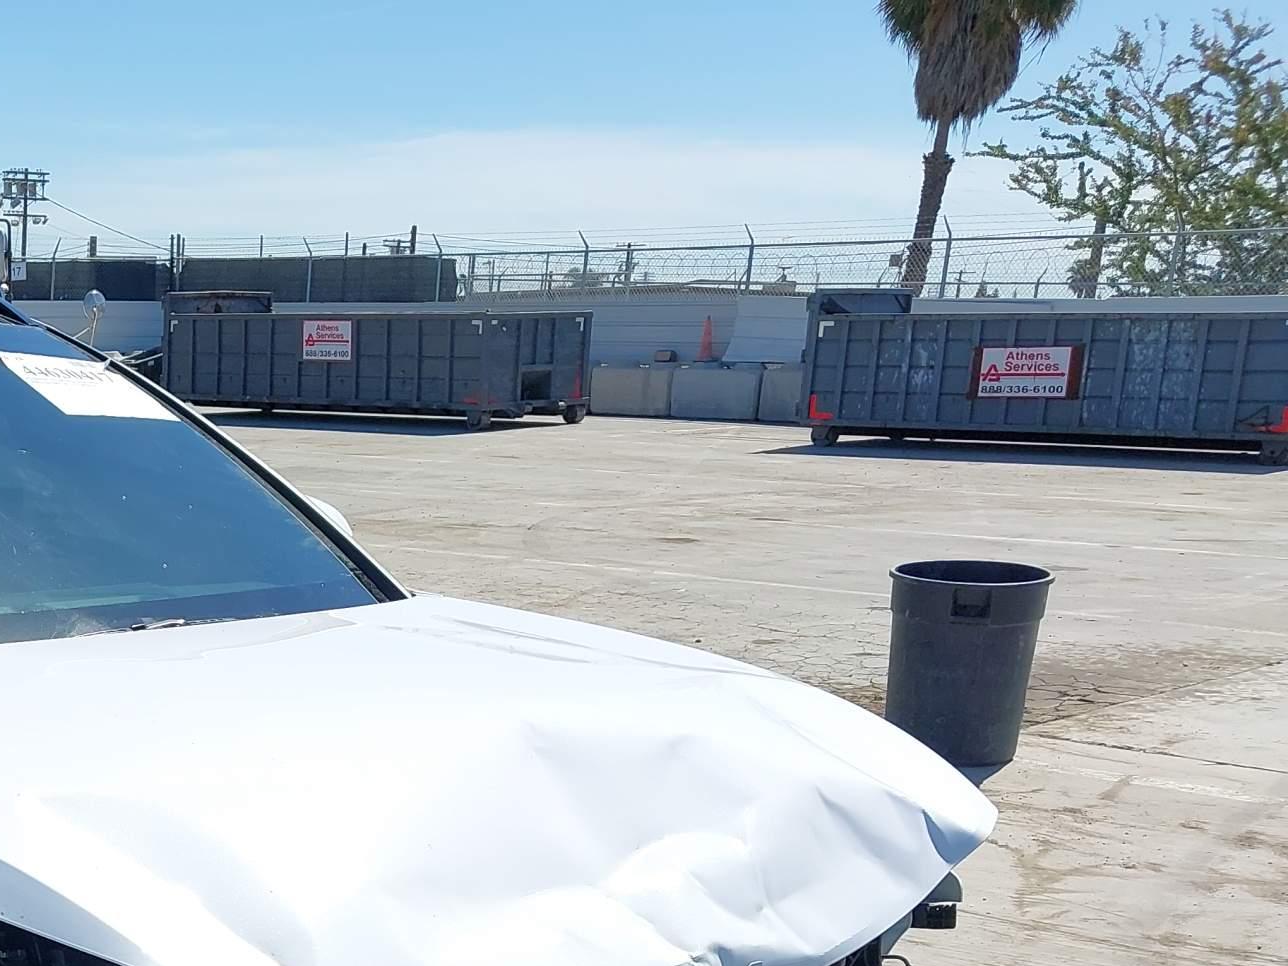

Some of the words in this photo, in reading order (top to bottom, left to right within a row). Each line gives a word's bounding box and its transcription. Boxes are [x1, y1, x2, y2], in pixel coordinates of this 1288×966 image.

[12, 266, 22, 277] 17
[316, 324, 339, 332] Athens
[316, 332, 344, 340] Services
[1006, 351, 1051, 361] Athens
[1004, 361, 1060, 372] Services
[980, 385, 1064, 394] 888/336-6100
